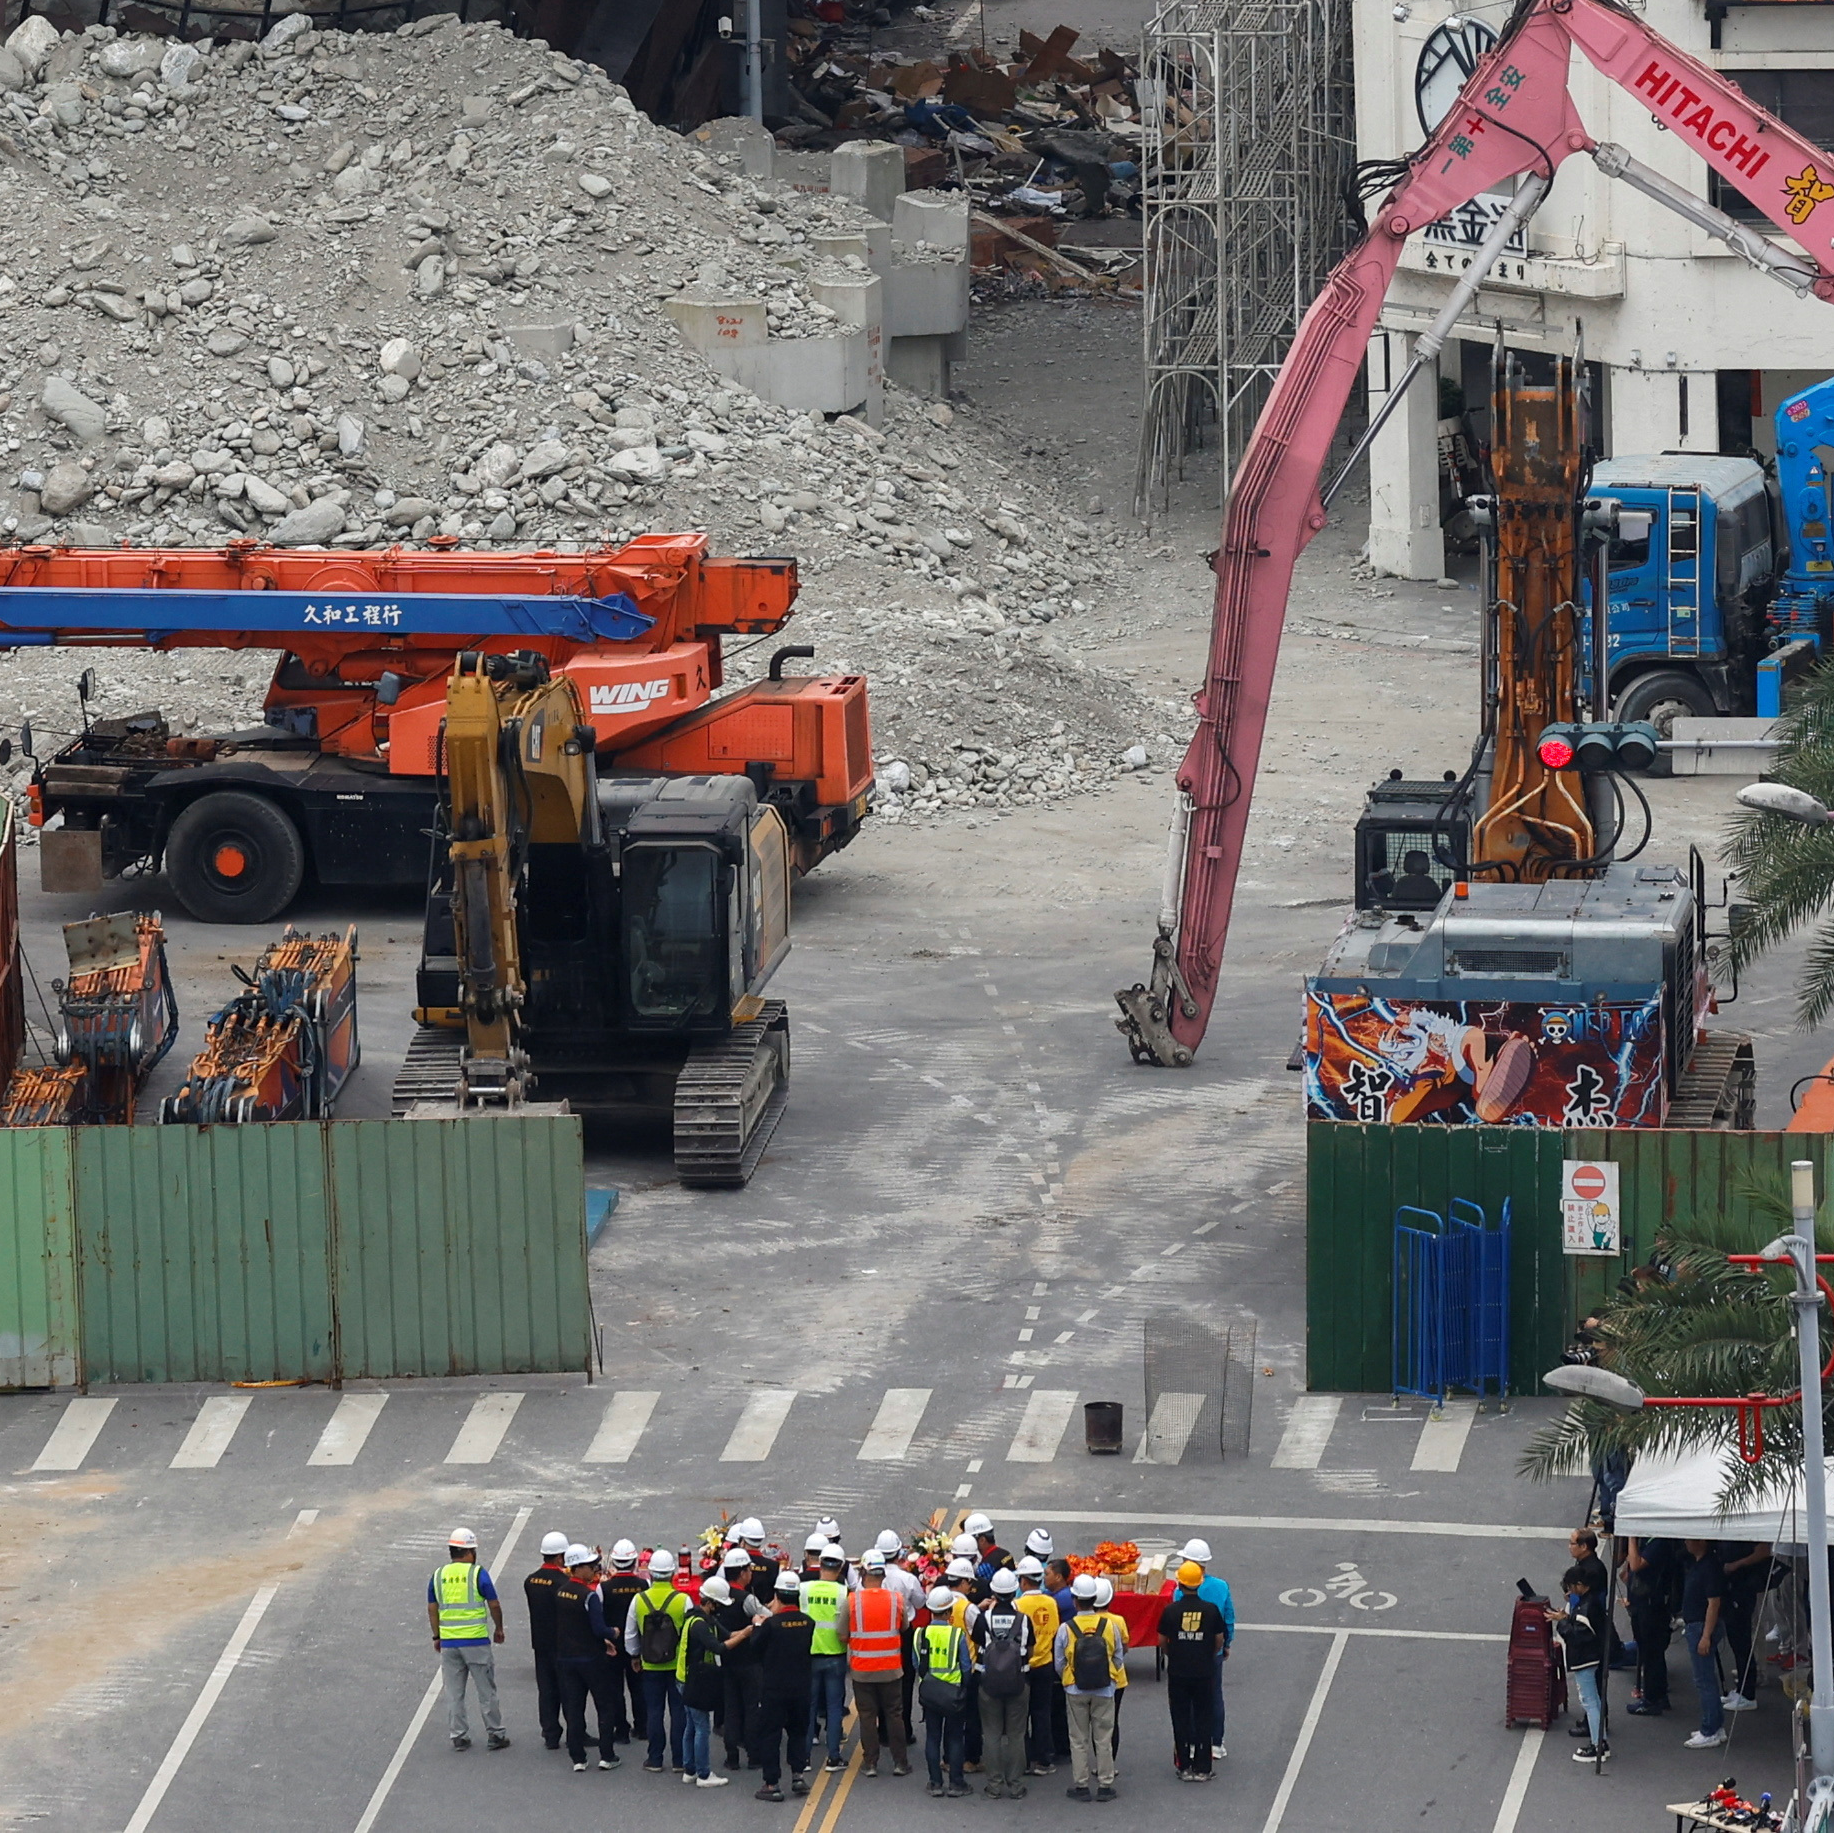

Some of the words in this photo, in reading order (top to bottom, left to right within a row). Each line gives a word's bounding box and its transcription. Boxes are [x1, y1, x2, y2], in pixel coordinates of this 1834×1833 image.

[1633, 60, 1772, 181] HITACHI
[302, 603, 403, 627] 久和工程行
[589, 678, 671, 706] WING
